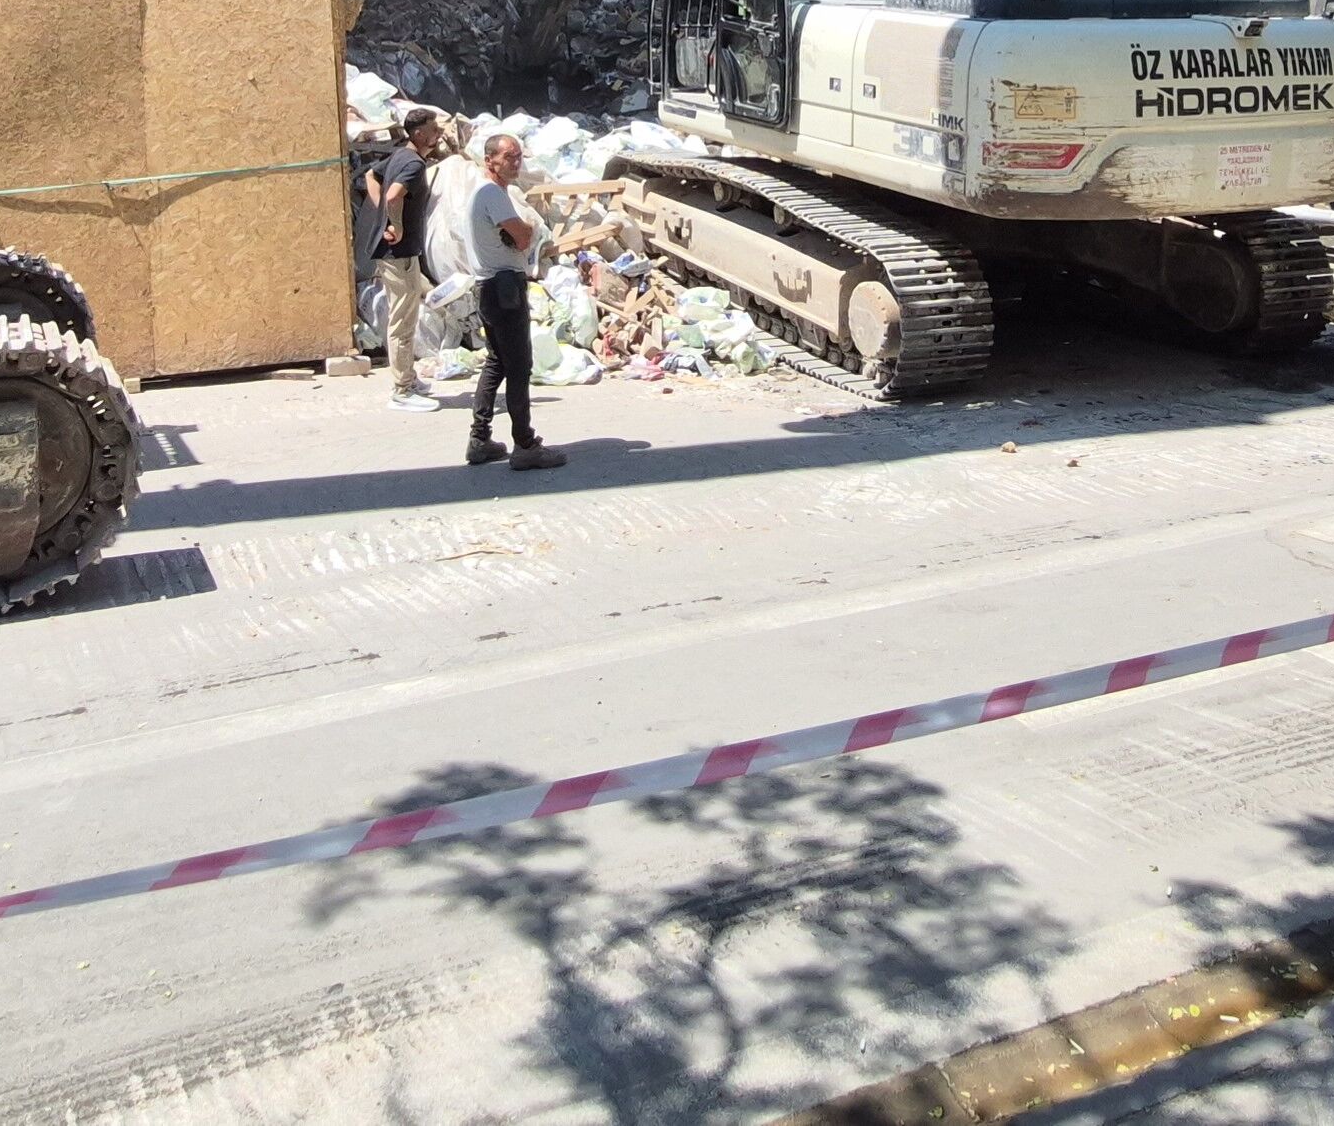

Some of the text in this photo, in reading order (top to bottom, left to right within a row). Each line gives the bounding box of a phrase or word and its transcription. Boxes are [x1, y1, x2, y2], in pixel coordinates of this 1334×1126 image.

[1130, 43, 1334, 81] ÖZ KARALAR YIKIM
[931, 113, 964, 131] HMK
